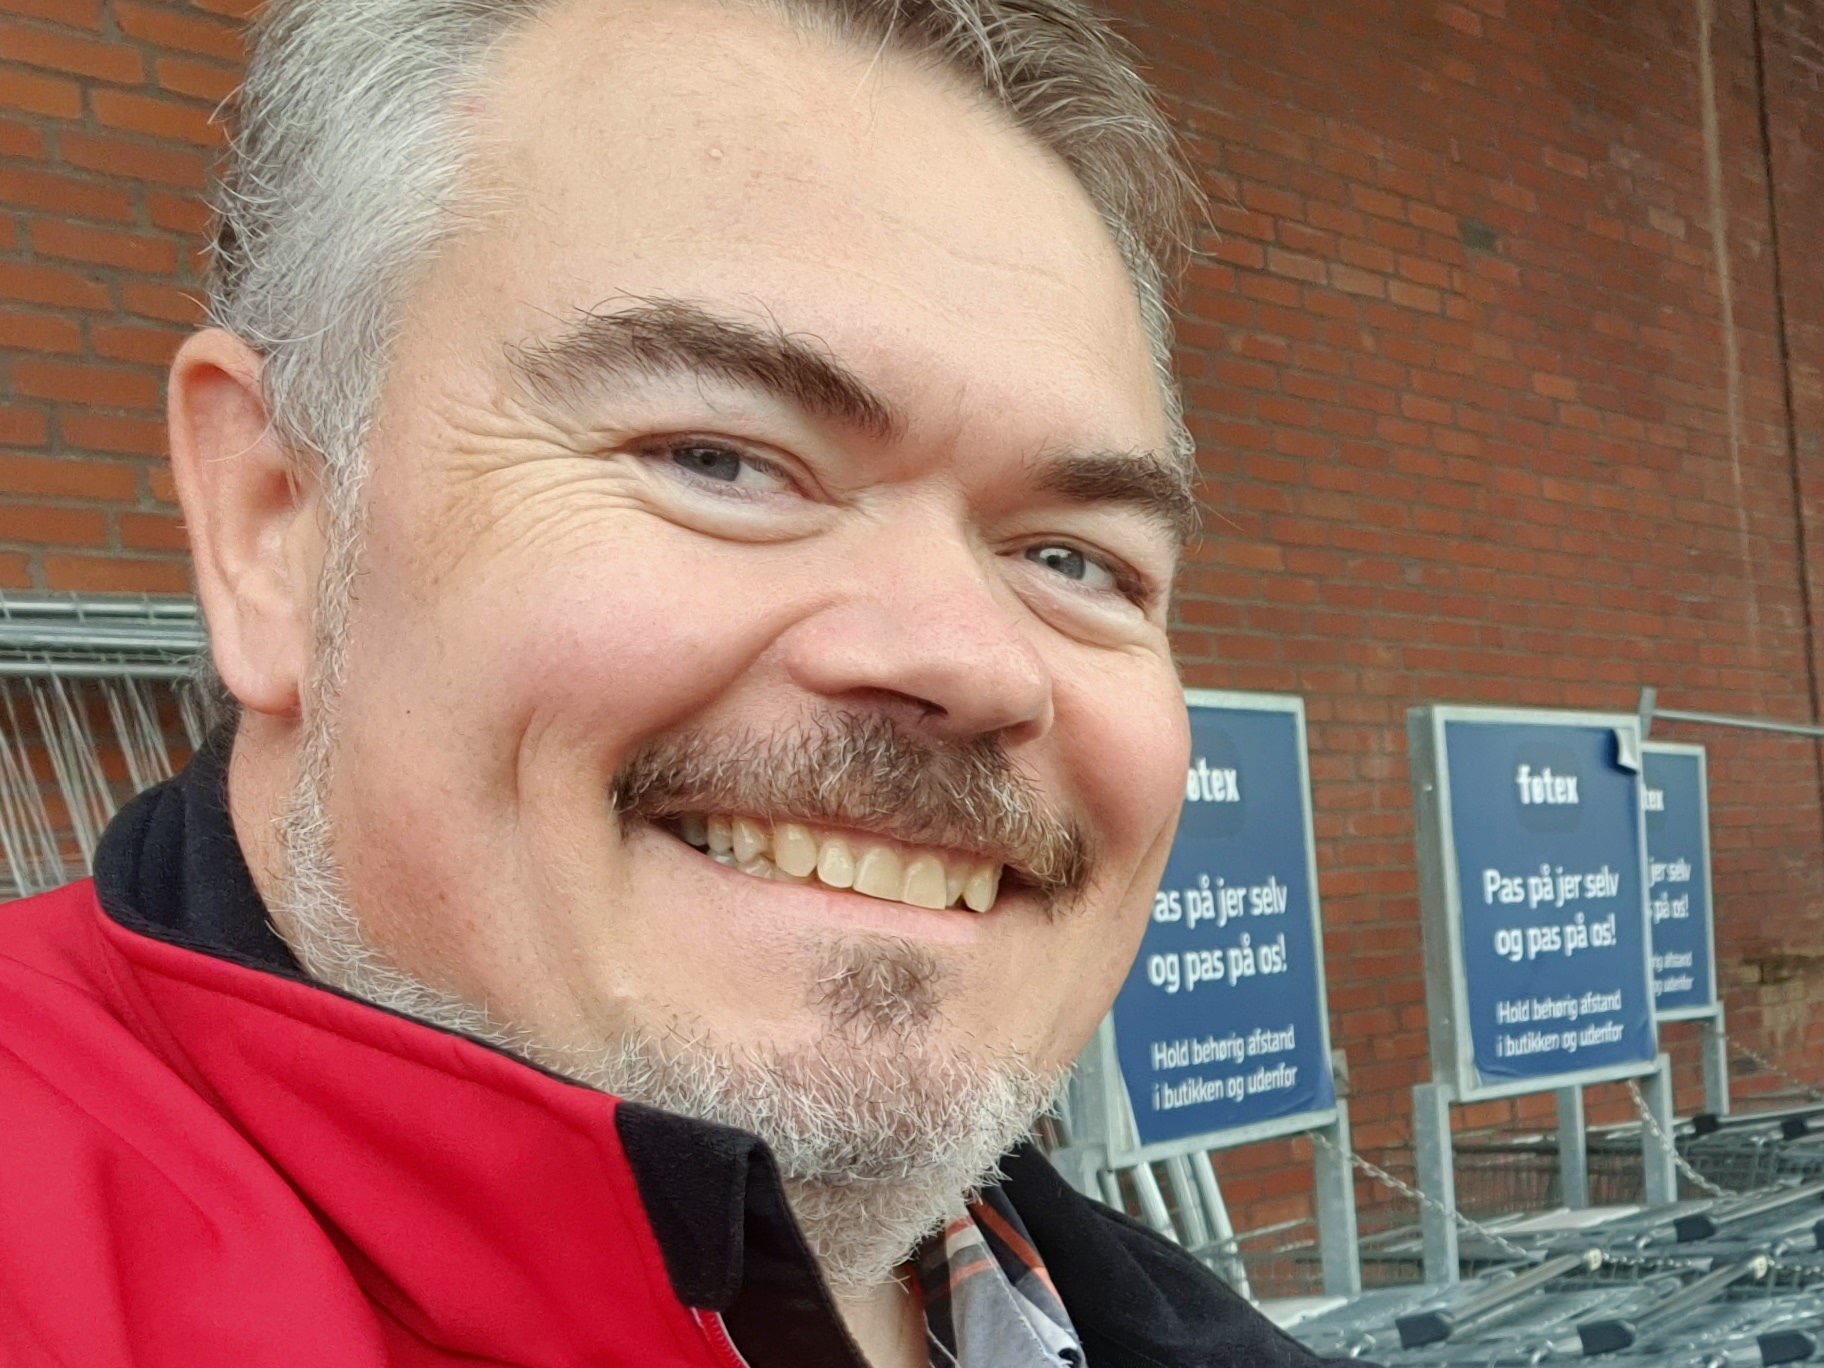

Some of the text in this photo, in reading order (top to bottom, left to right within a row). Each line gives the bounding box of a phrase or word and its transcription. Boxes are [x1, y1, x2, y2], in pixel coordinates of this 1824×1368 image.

[1186, 756, 1240, 802] øtex
[1516, 764, 1579, 805] føtex
[1643, 787, 1664, 811] tex
[1153, 874, 1288, 928] as på jer selv
[1482, 863, 1620, 909] Pas på jer selv
[1494, 911, 1617, 962] og pas på os!
[1147, 932, 1287, 993] og pas på os!
[1496, 989, 1622, 1024] Hold behørig afstand
[1152, 1024, 1295, 1070] Hold behørig afstand
[1496, 1034, 1504, 1057] i
[1506, 1029, 1560, 1057] butikken
[1562, 1030, 1577, 1052] og
[1152, 1065, 1298, 1111] i butikken og udenfor
